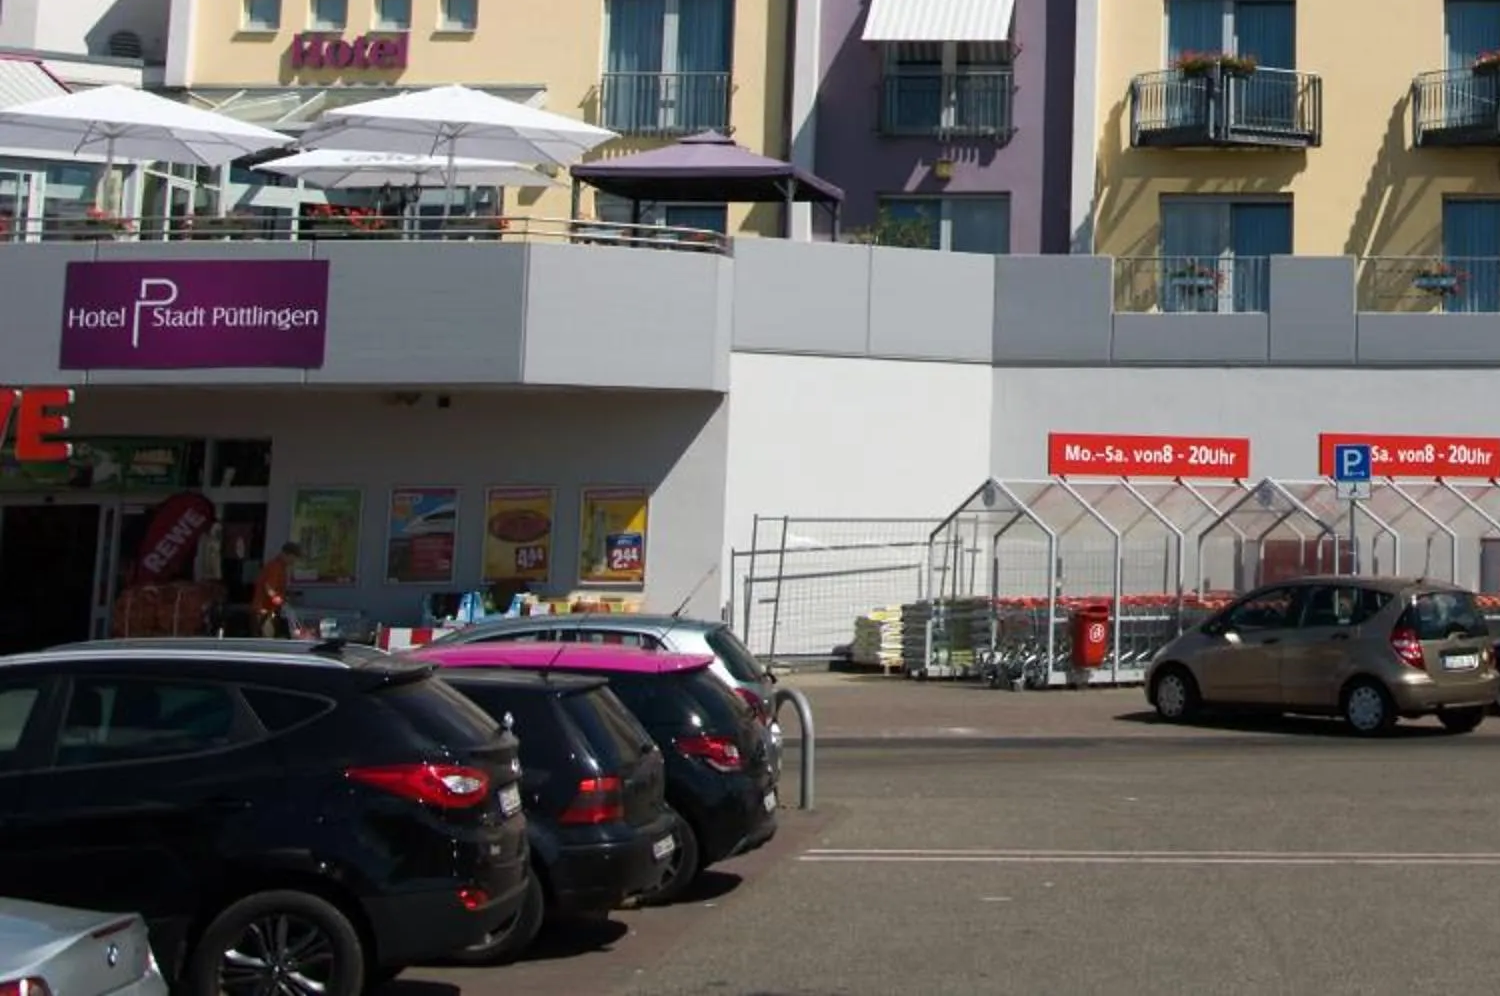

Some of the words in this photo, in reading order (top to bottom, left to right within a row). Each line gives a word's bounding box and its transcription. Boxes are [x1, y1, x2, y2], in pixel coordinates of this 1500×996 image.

[291, 31, 409, 70] Hotel
[67, 306, 126, 329] Hotel
[151, 306, 206, 328] Stadt
[211, 306, 320, 331] Püttlingen
[1133, 444, 1174, 464] von8
[1187, 445, 1237, 466] 20Uhr
[1343, 448, 1363, 477] P
[1397, 443, 1435, 464] von8
[1448, 444, 1494, 466] 20Uhr
[141, 507, 208, 573] REWE
